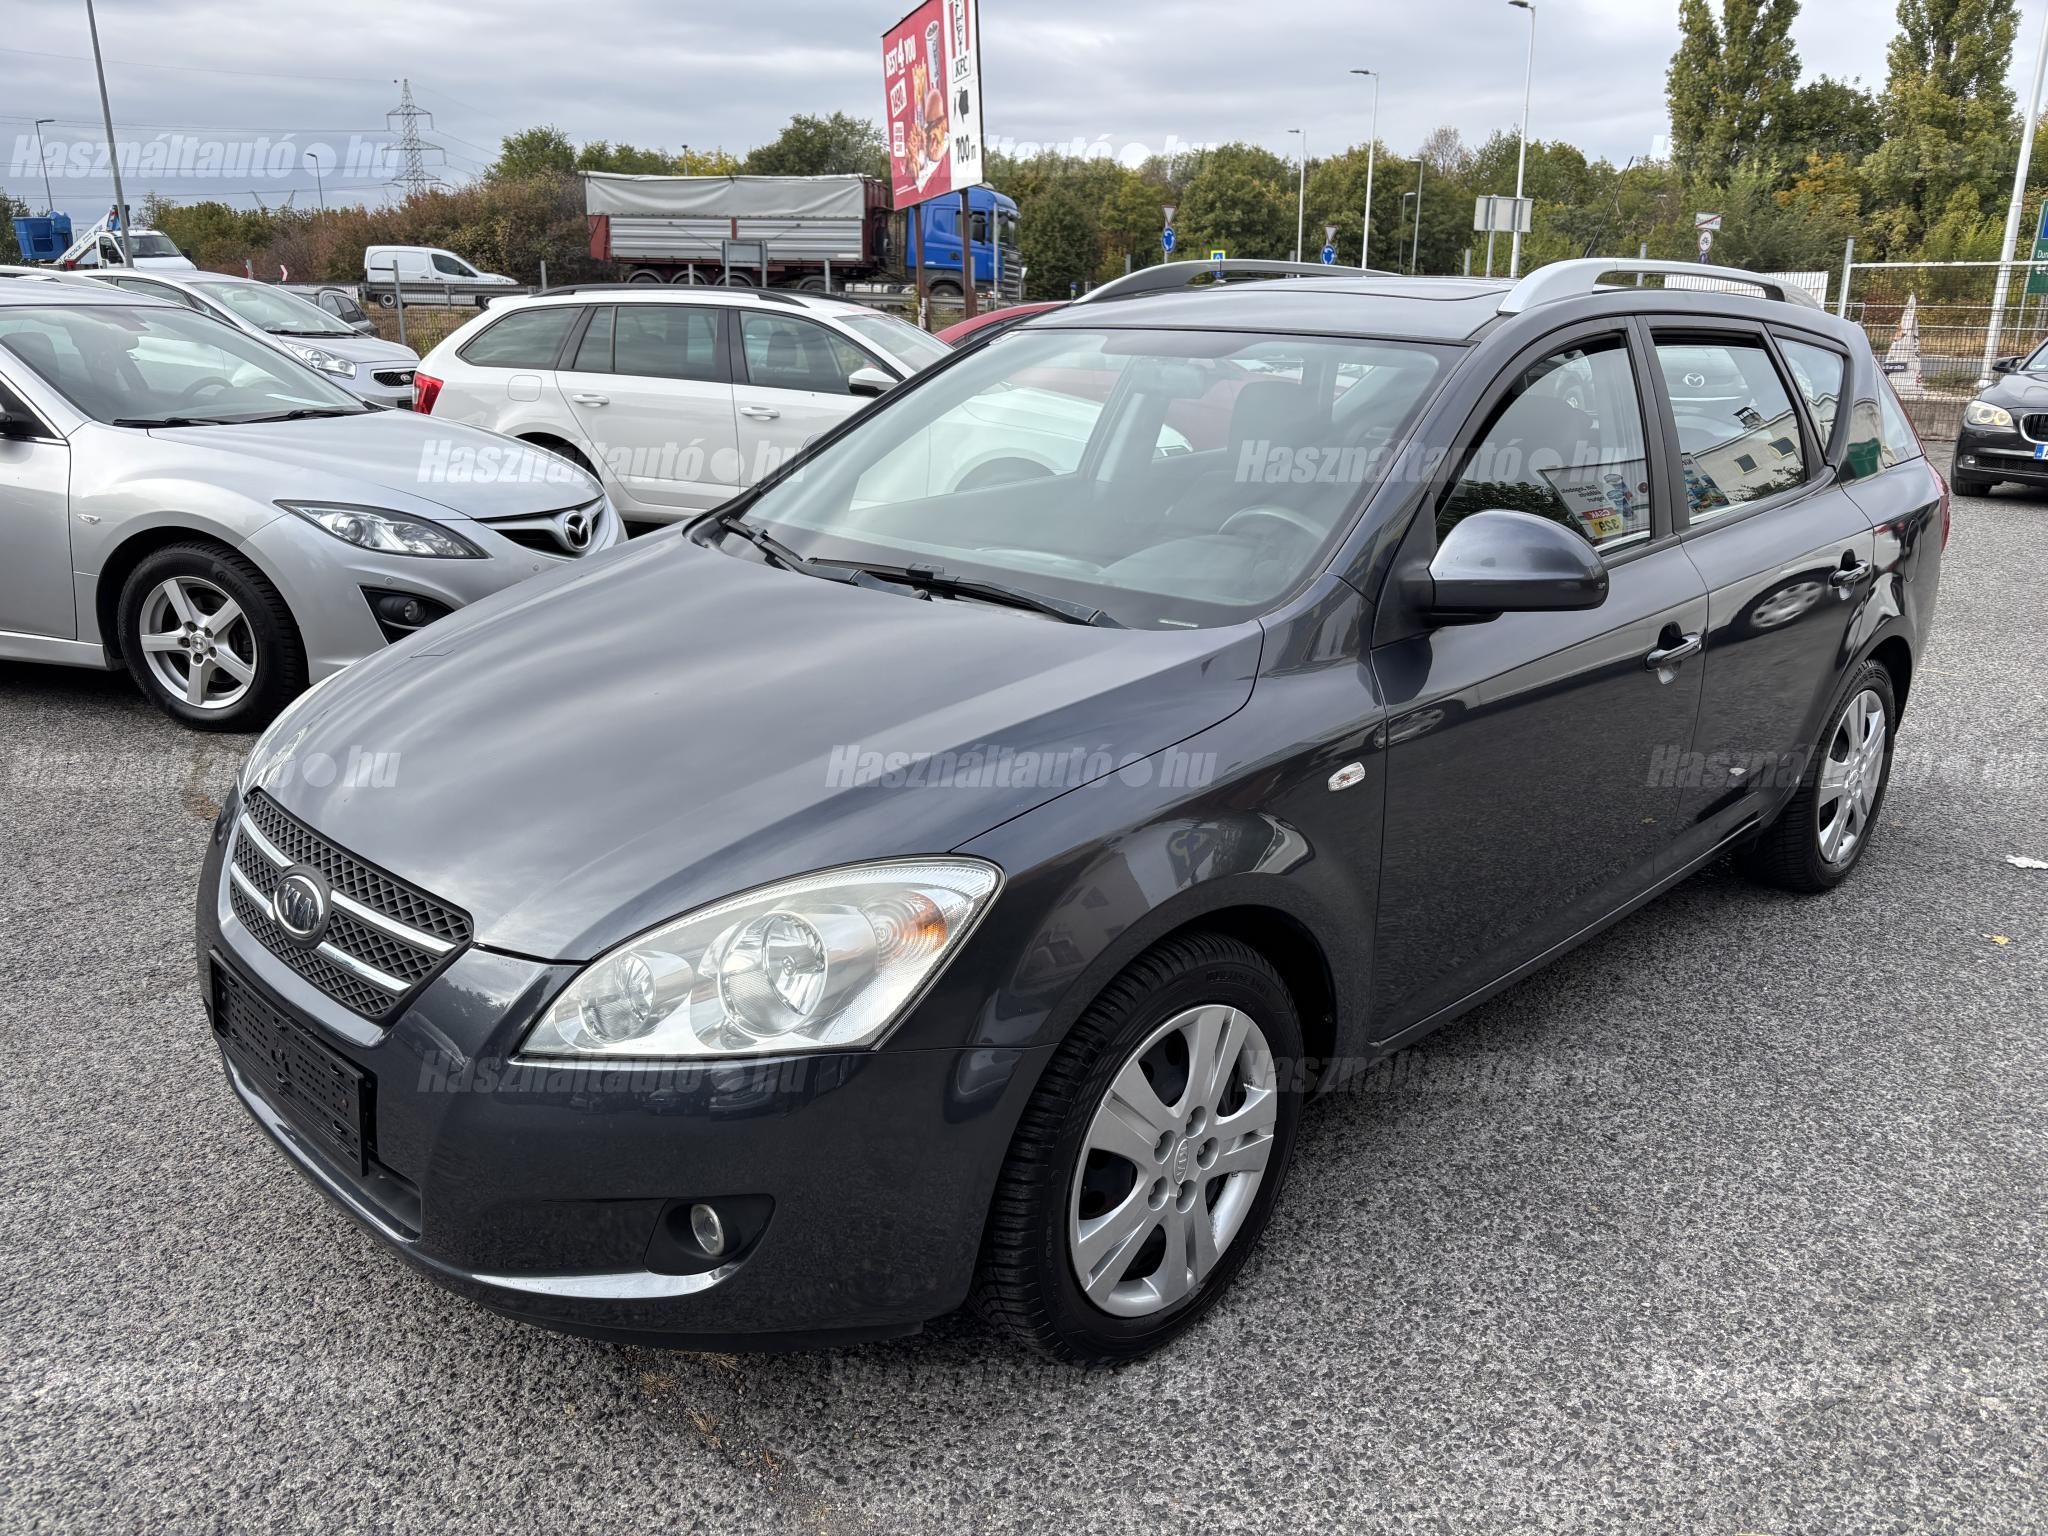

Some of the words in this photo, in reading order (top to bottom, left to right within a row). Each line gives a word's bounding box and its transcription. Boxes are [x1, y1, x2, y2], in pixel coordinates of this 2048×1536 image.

[897, 38, 905, 69] 4
[904, 34, 916, 64] YOU
[955, 55, 968, 77] KFC
